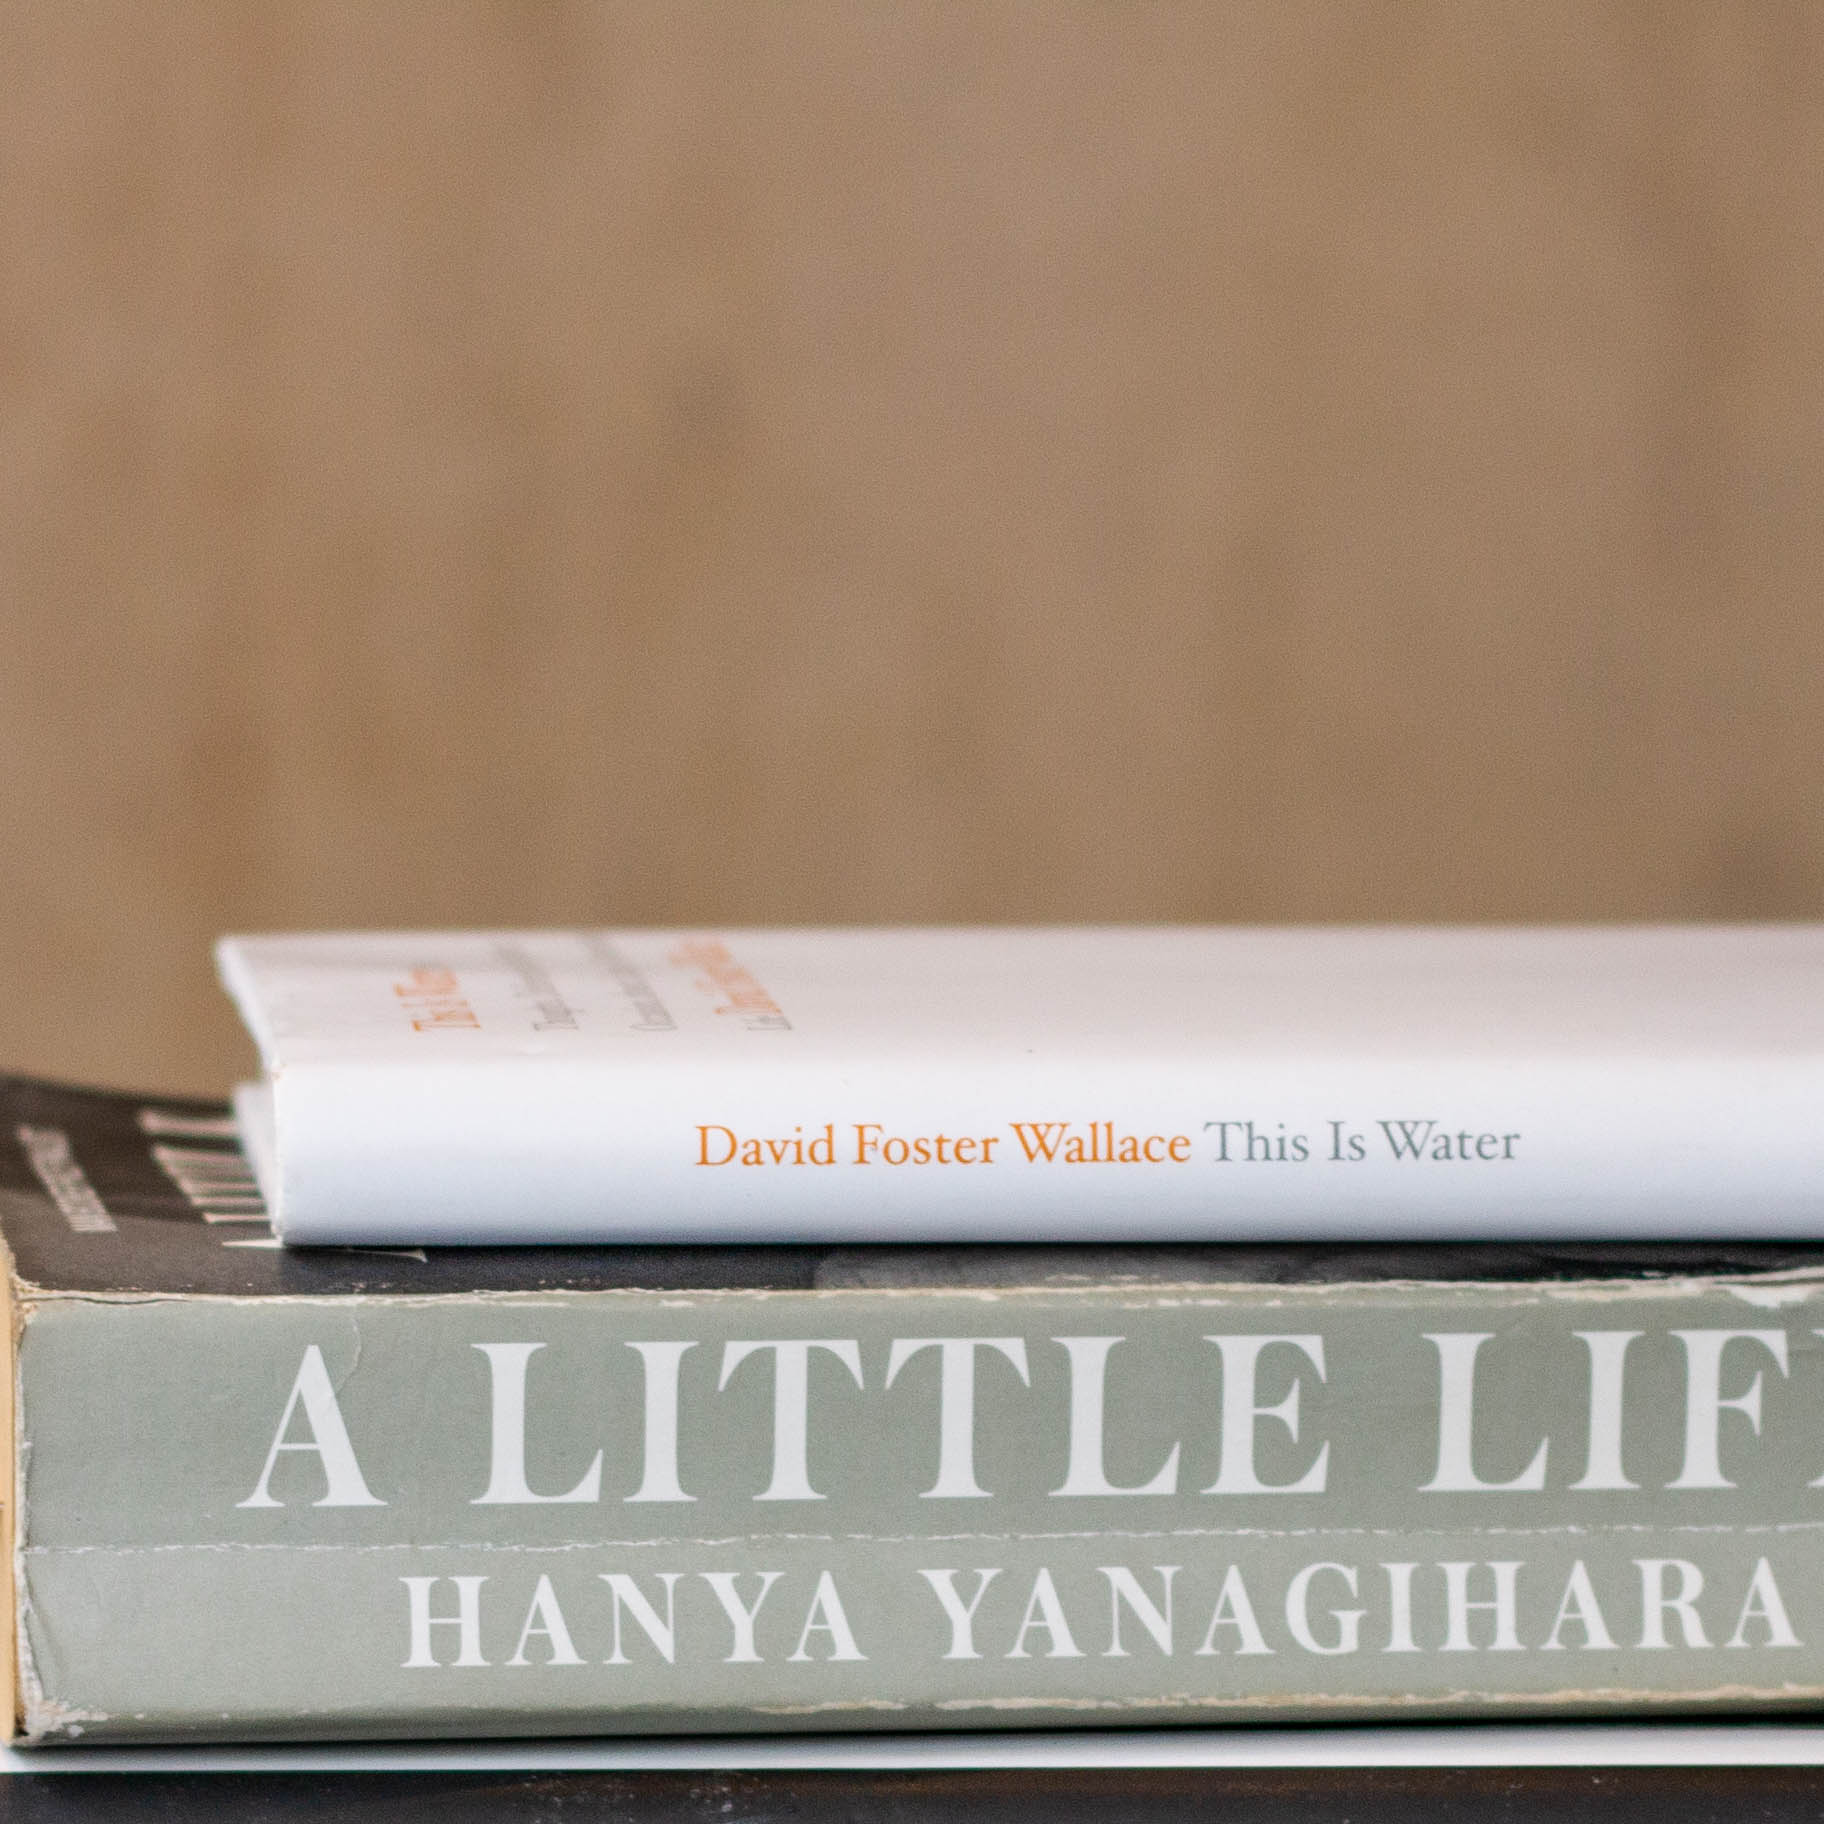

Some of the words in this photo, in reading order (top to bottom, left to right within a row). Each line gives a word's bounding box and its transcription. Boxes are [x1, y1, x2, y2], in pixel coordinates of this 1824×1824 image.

[695, 1122, 835, 1167] David
[851, 1122, 999, 1166] Foster
[1009, 1121, 1192, 1165] Wallace
[1203, 1119, 1310, 1163] This
[1327, 1119, 1367, 1162] Is
[1376, 1119, 1521, 1162] Water
[234, 1343, 388, 1510] A
[469, 1333, 1331, 1507] LITTLE
[399, 1568, 869, 1670] HANYA
[917, 1555, 1804, 1664] YANAGIHARA
